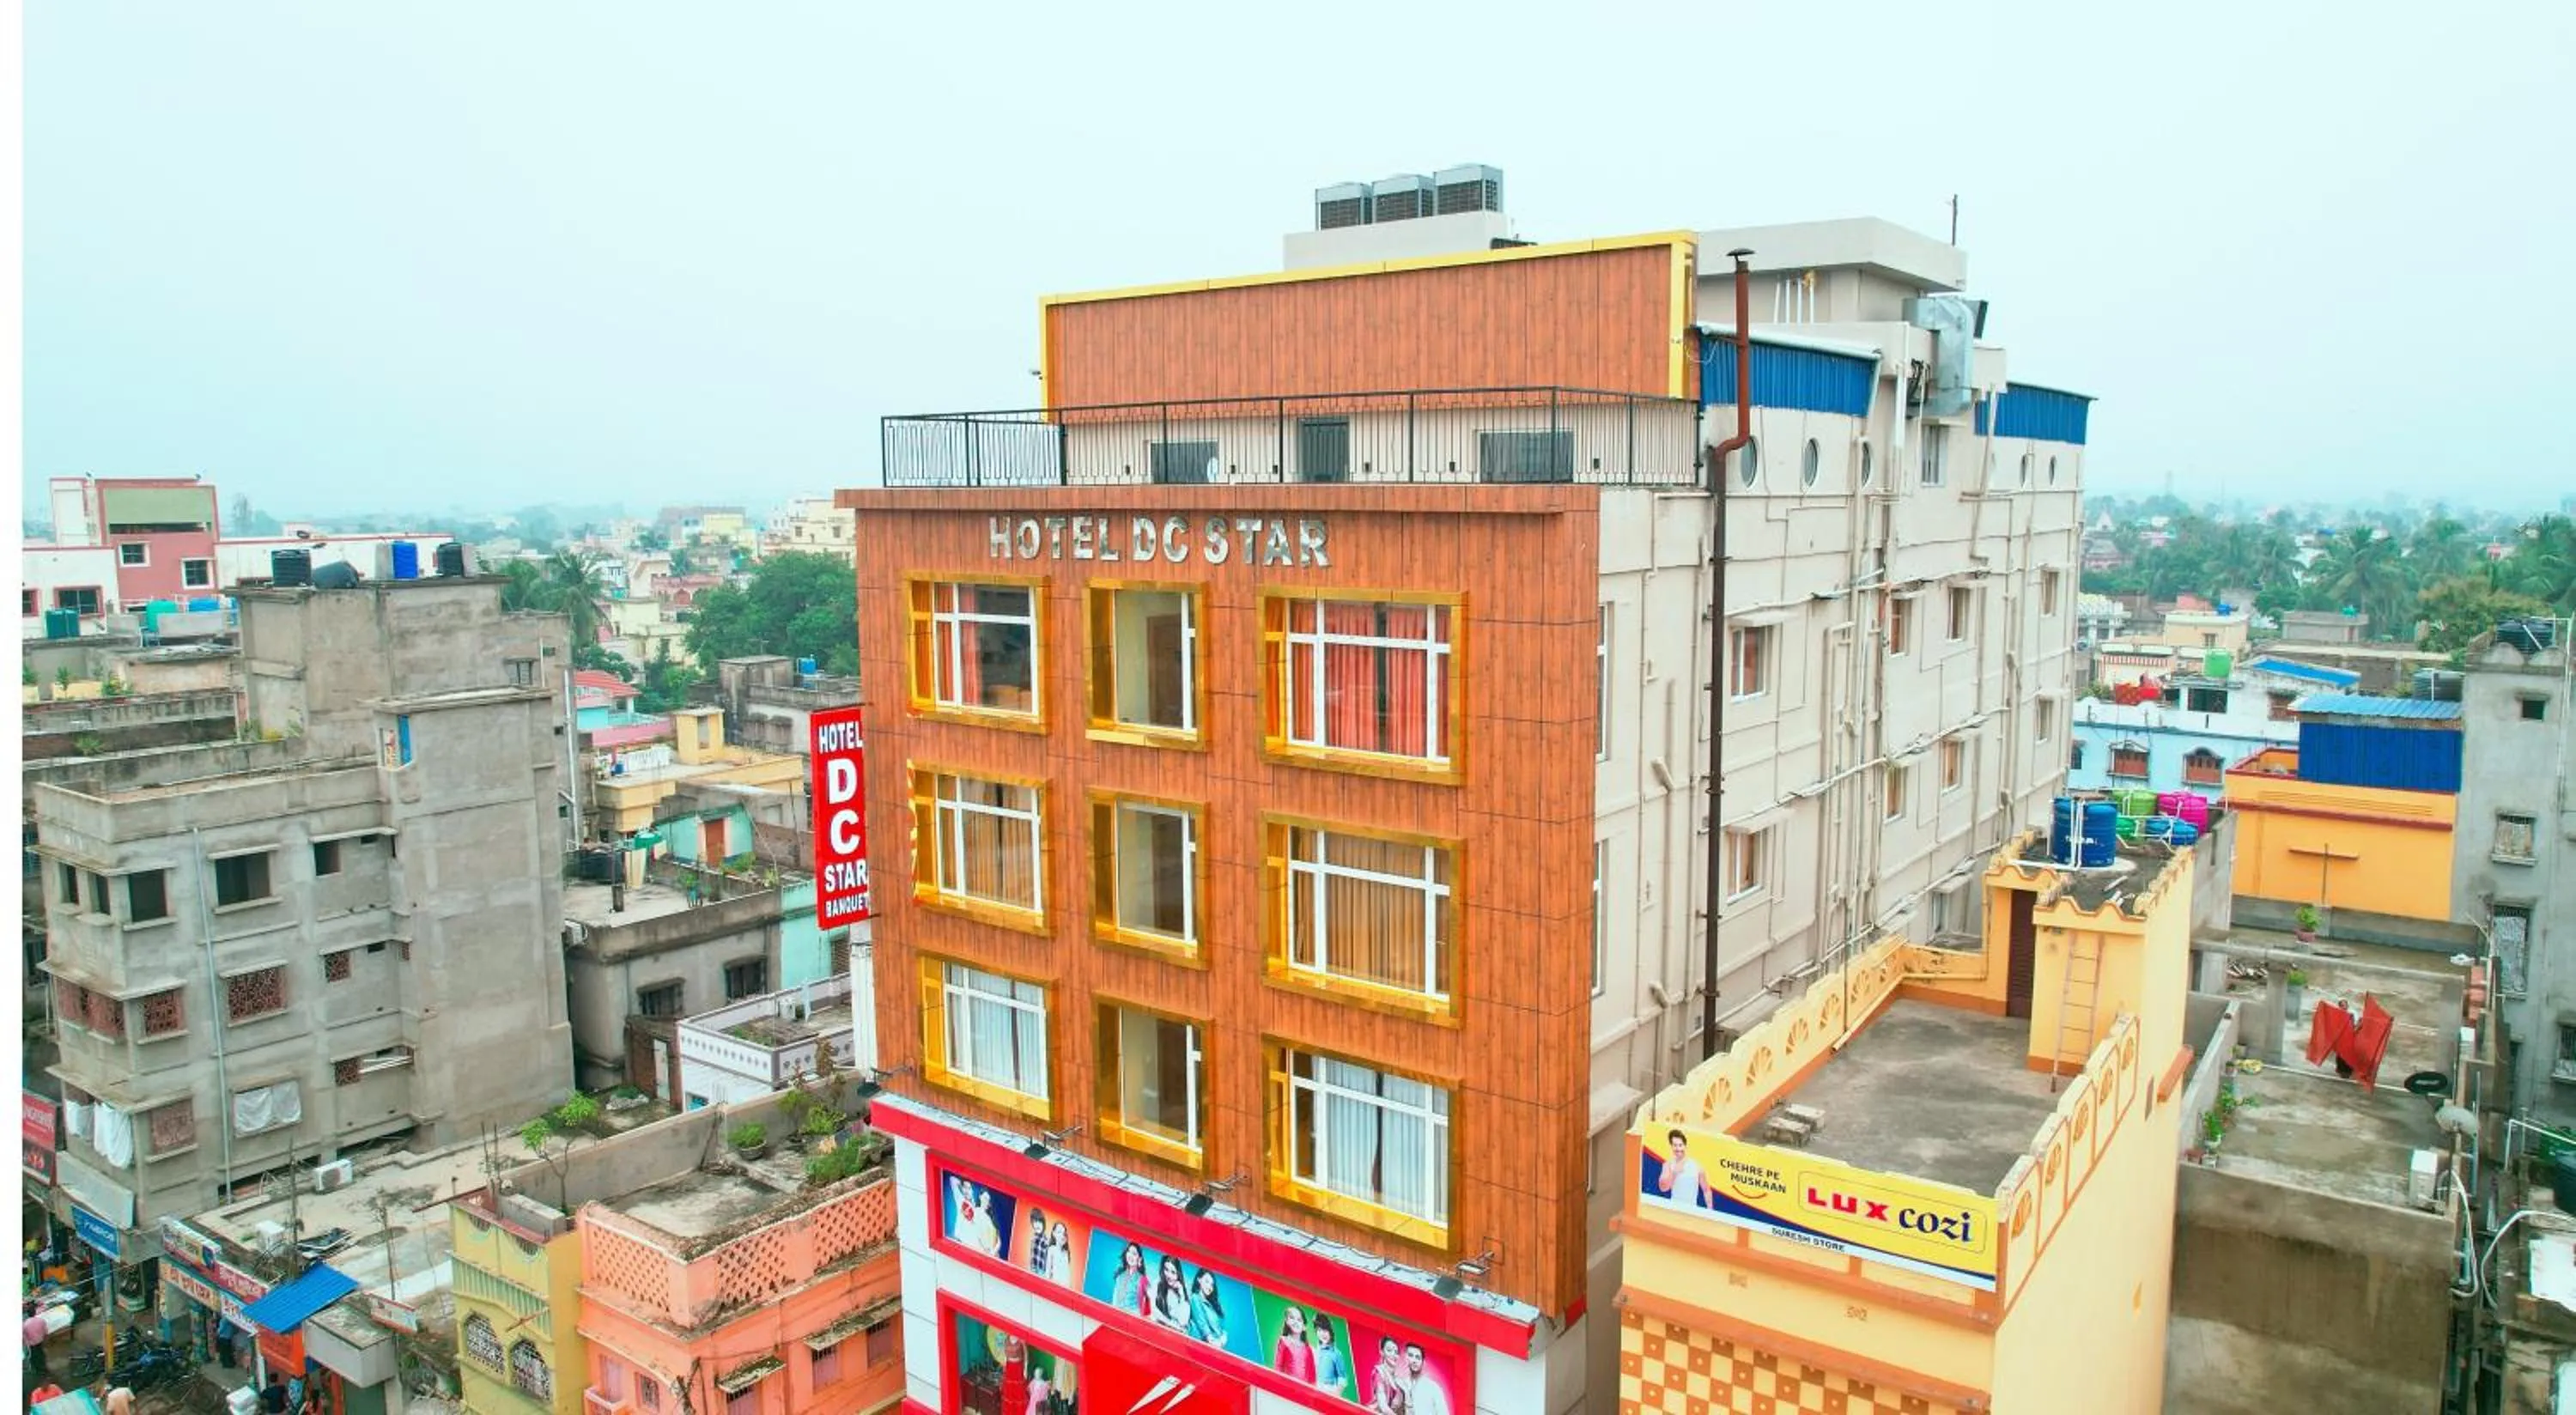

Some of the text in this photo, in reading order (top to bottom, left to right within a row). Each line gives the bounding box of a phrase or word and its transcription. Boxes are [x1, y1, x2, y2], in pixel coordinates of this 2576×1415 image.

[989, 516, 1330, 568] HOTEL DC STAR
[818, 721, 863, 754] HOTEL
[825, 859, 867, 893] STAR
[1720, 1158, 1781, 1181] CHEHRE PE
[1730, 1172, 1787, 1194] MUSKAAN
[1807, 1187, 1971, 1242] LUX cozi
[1771, 1227, 1845, 1253] SURESH STORE
